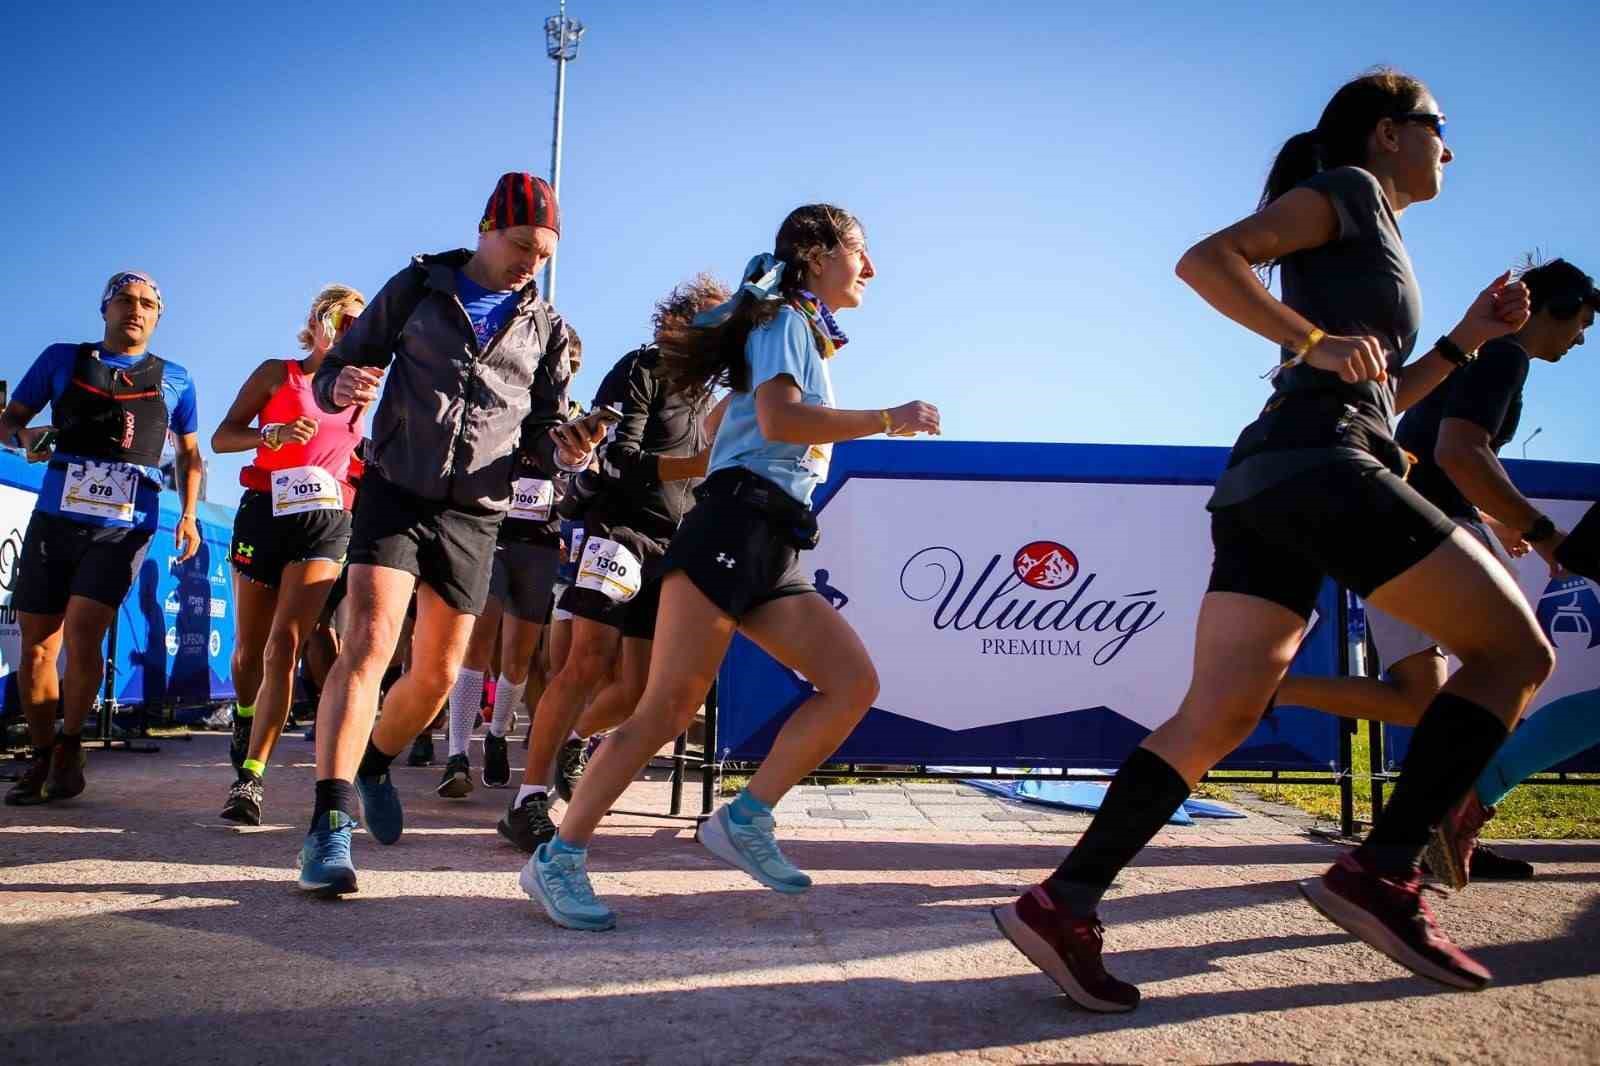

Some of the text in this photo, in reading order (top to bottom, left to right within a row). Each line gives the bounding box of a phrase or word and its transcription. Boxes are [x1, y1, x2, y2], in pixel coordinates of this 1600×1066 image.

[89, 484, 113, 496] 878
[293, 483, 322, 496] 1013
[515, 493, 539, 505] 1067
[596, 557, 627, 578] 1300
[981, 638, 1083, 657] PREMIUM
